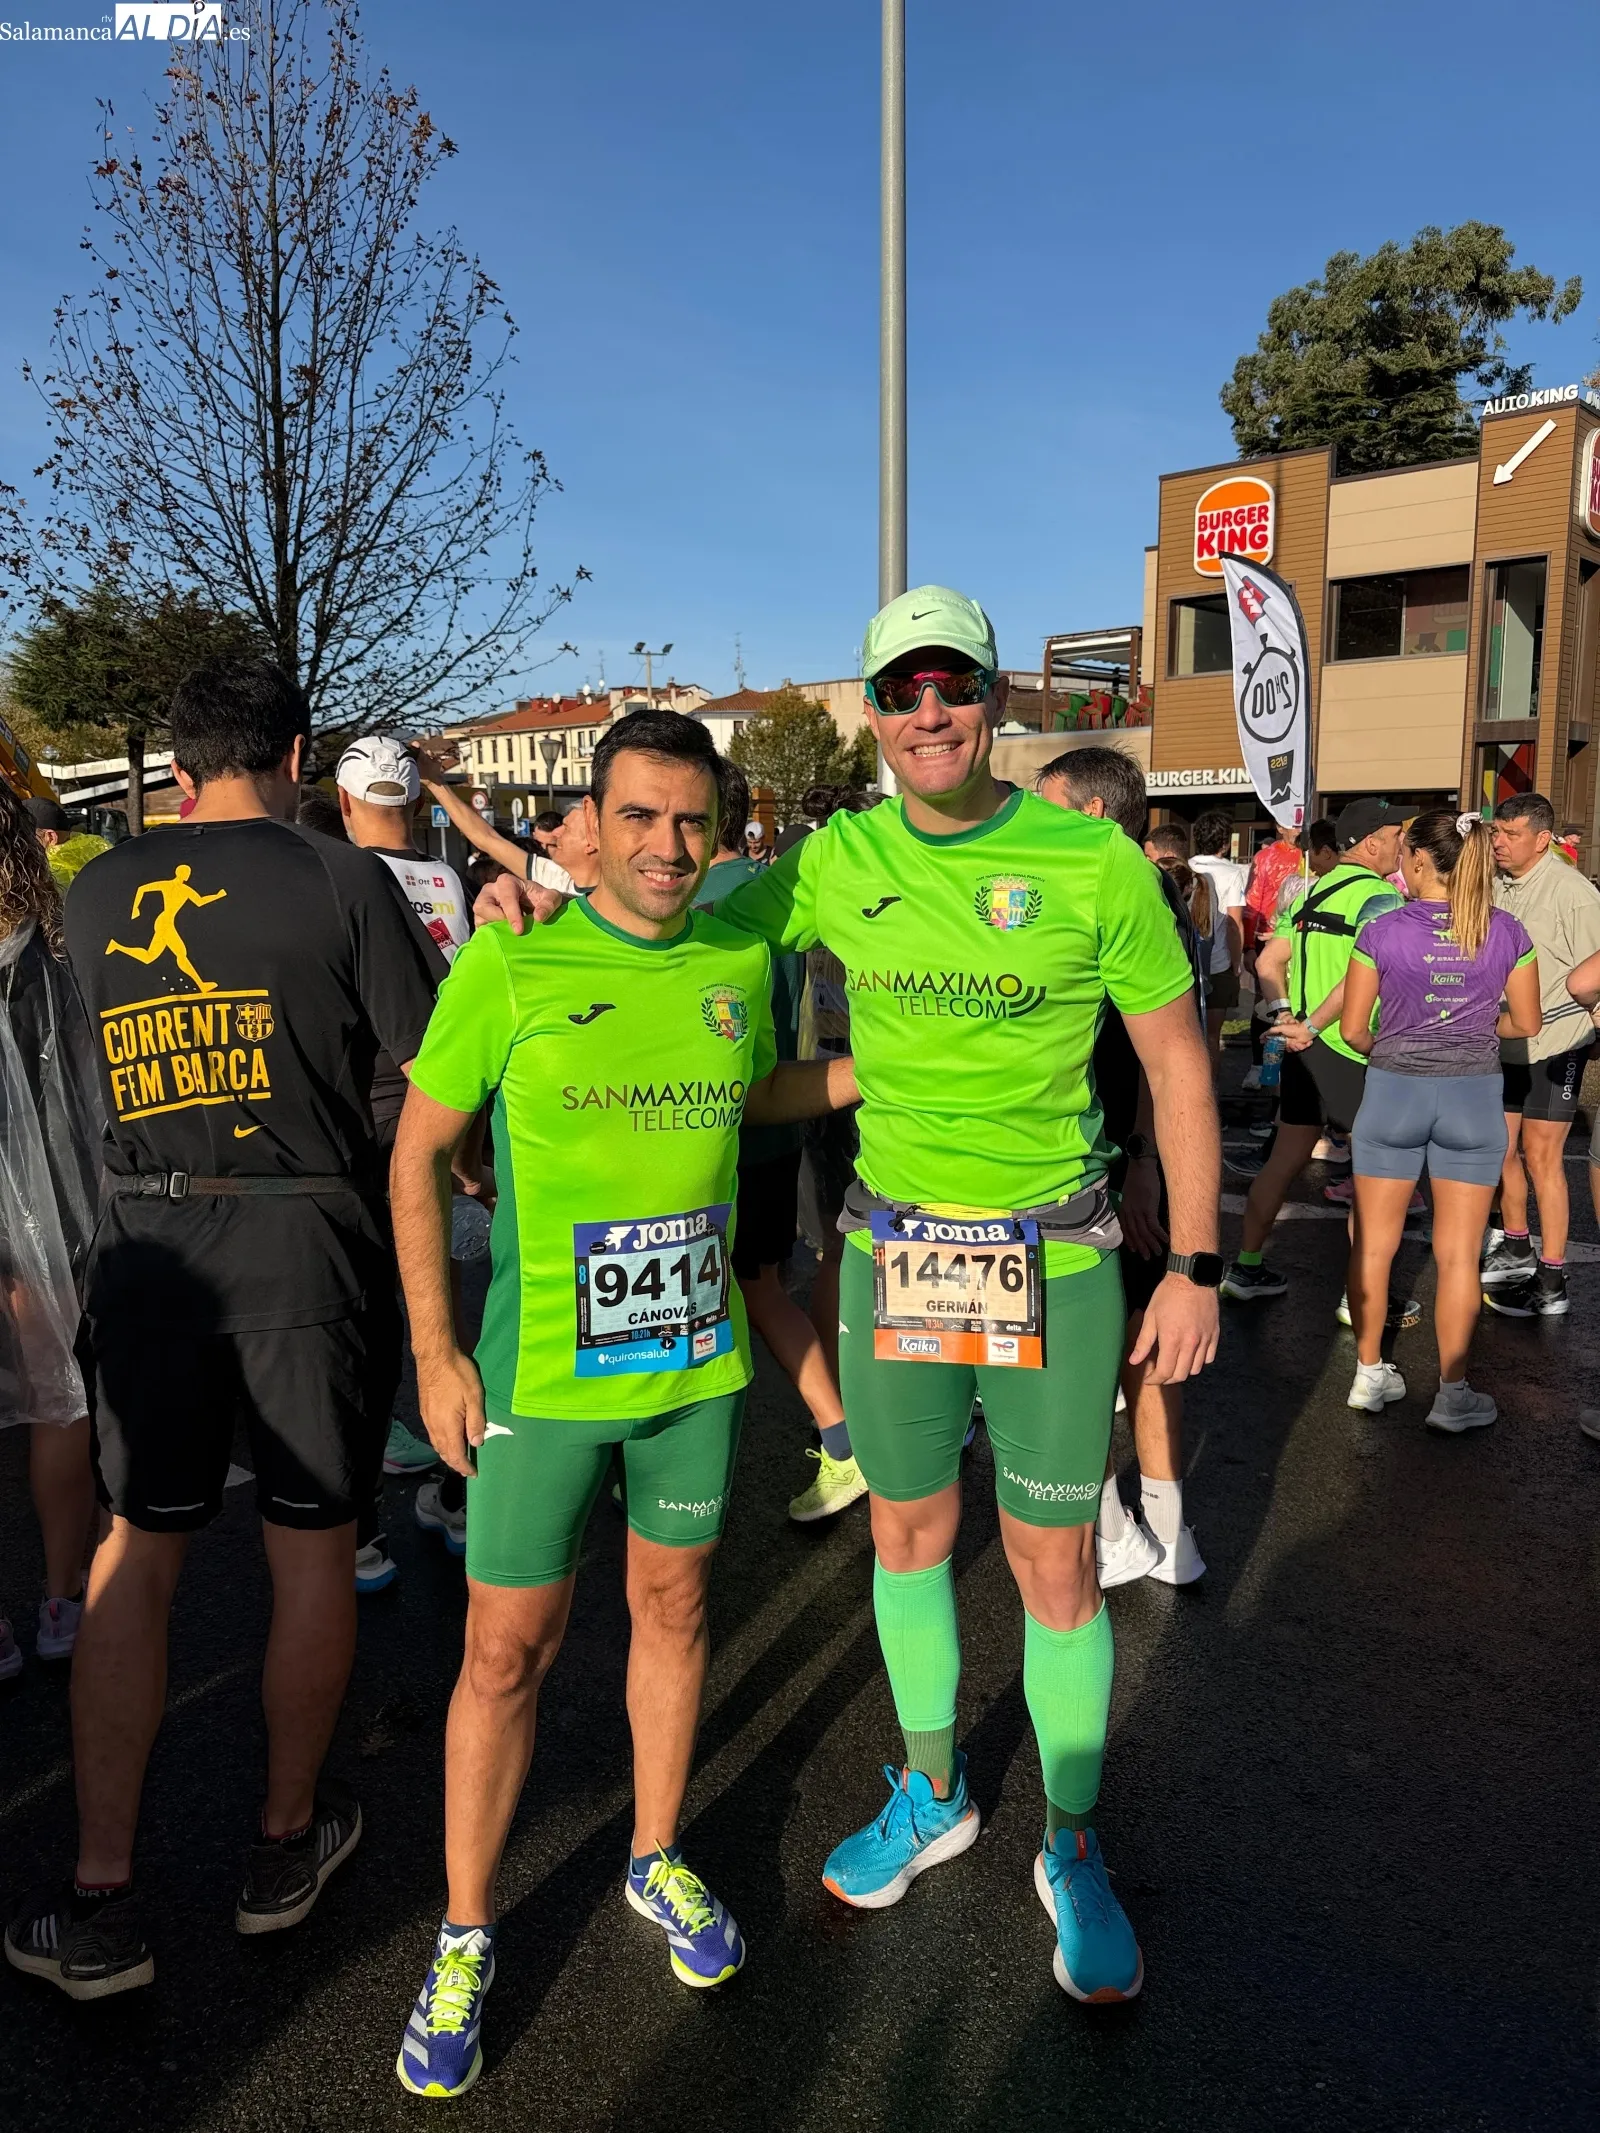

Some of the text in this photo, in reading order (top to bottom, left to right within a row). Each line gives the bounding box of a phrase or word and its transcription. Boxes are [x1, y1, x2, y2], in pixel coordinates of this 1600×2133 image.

[1198, 504, 1270, 533] BURGER
[1197, 524, 1270, 558] KING
[1145, 767, 1252, 788] BURGER KIN
[847, 969, 1023, 998] SANMAXIMO
[1433, 974, 1462, 985] Kaiku
[894, 995, 1007, 1019] TELECOM
[103, 1003, 231, 1065] CORRENT
[110, 1060, 165, 1111] FEM
[562, 1080, 745, 1111] SANMAXIMO
[629, 1106, 735, 1132] TELECOM
[594, 1244, 721, 1308] 9414
[891, 1251, 1024, 1293] 14476
[628, 1301, 697, 1325] CÁNOVAS
[926, 1299, 988, 1315] GERMÁN
[1005, 1323, 1022, 1332] delta
[900, 1338, 937, 1353] Kaiku
[1003, 1466, 1095, 1494] SANMAXIMO
[1027, 1487, 1088, 1502] TELECOM
